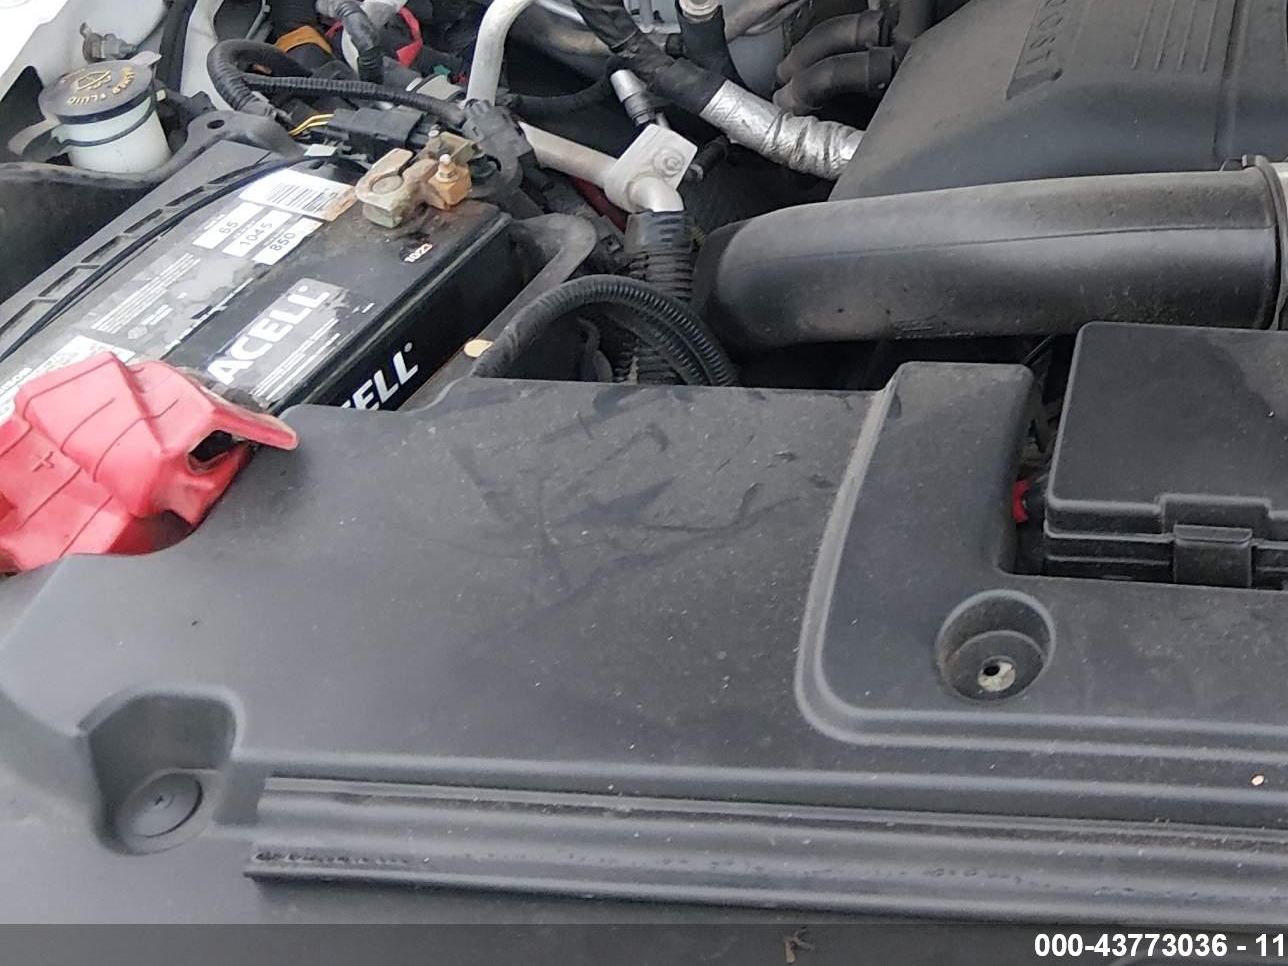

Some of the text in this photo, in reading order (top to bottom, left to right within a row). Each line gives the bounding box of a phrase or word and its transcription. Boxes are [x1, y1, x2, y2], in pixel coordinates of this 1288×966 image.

[219, 220, 240, 235] 65
[239, 222, 273, 247] 1045
[270, 232, 296, 251] 850
[340, 350, 419, 410] ELL
